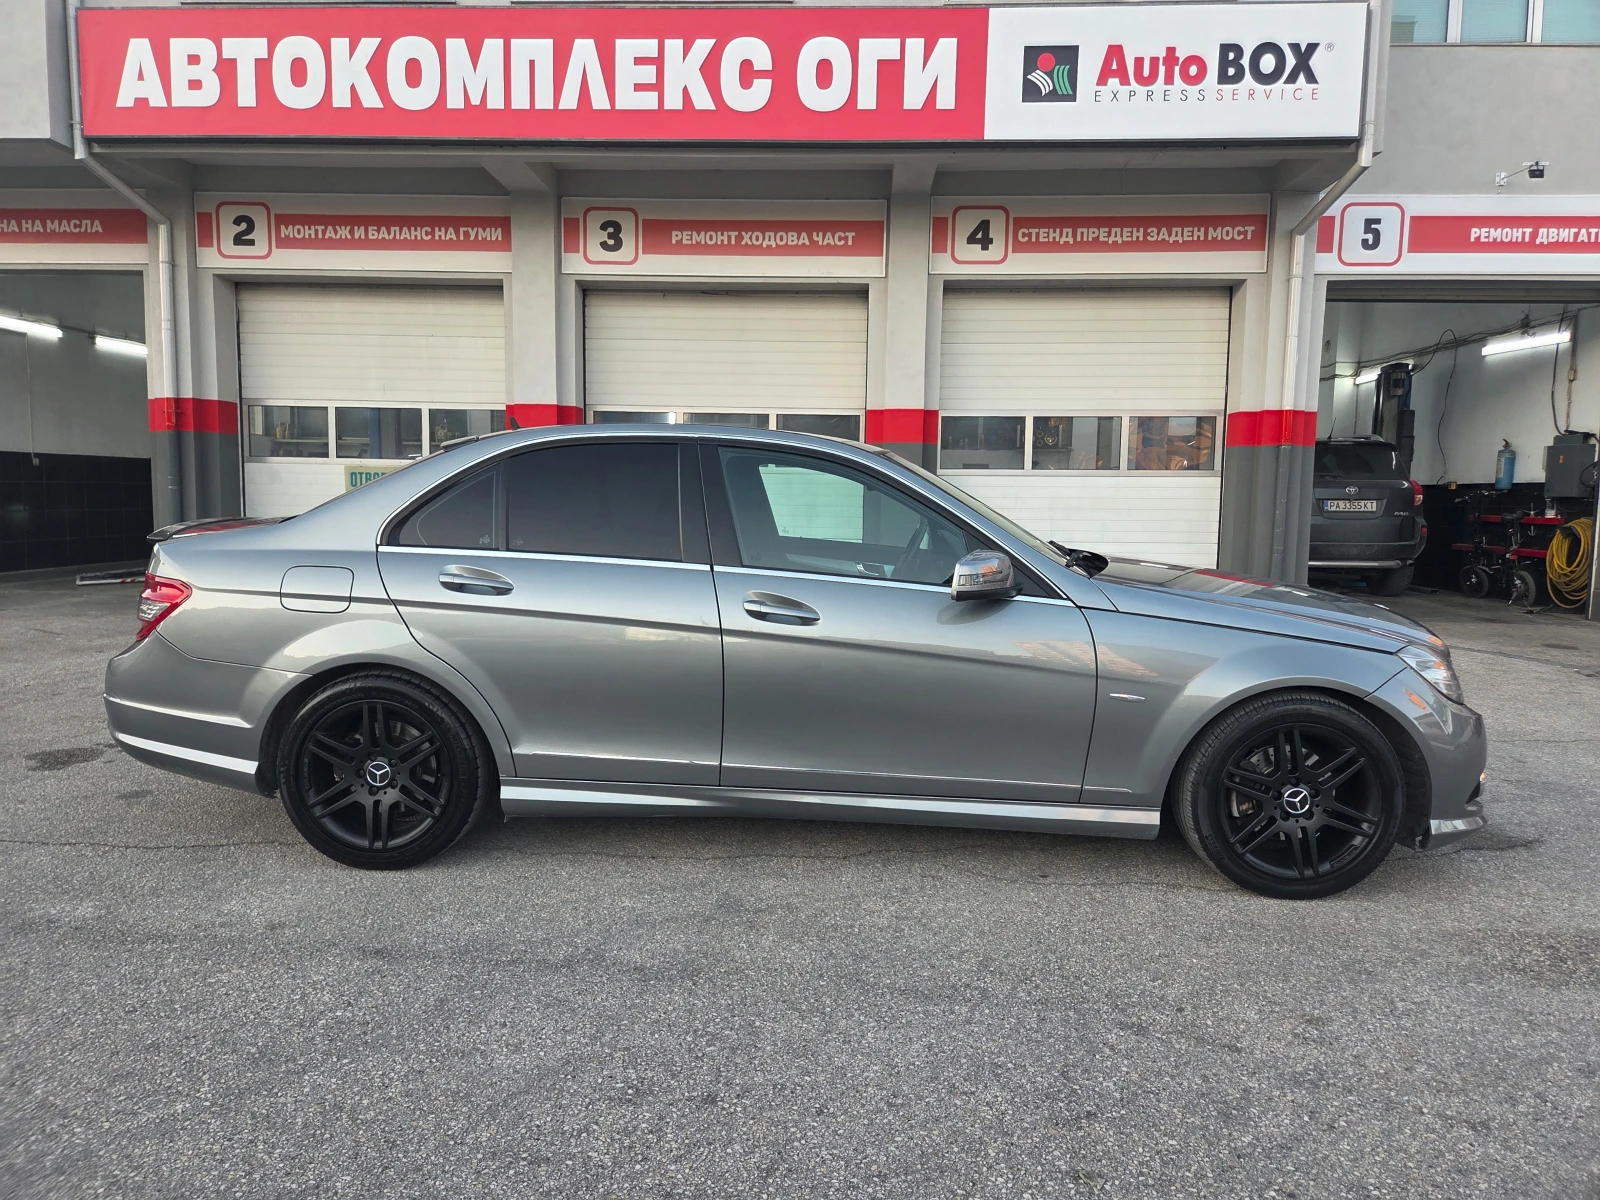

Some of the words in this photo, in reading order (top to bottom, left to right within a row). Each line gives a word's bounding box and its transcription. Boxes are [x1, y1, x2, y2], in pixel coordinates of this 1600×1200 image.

[115, 36, 773, 112] АВТОКОМПЛЕКС
[797, 36, 958, 111] ОГИ
[1096, 44, 1208, 86] Auto
[1217, 41, 1320, 85] BOX
[22, 219, 44, 233] НА
[46, 219, 103, 233] МАСЛА
[232, 214, 256, 247] 2
[280, 224, 351, 239] МОНТАЖ
[354, 225, 365, 239] И
[368, 226, 432, 240] БАЛАНС
[434, 227, 457, 240] НА
[459, 227, 502, 241] ГУМИ
[599, 219, 624, 253] 3
[671, 230, 739, 245] РЕМОНТ
[741, 231, 810, 248] ХОДОВА
[812, 231, 856, 246] ЧАСТ
[966, 218, 994, 251] 4
[1018, 228, 1074, 245] СТЕНД
[1076, 227, 1144, 244] ПРЕДЕН
[1146, 227, 1205, 244] ЗАДЕН
[1207, 226, 1255, 241] МОСТ
[1360, 217, 1382, 251] 5
[1470, 227, 1533, 243] РЕМОНТ
[1535, 227, 1600, 245] ДВИГАТ
